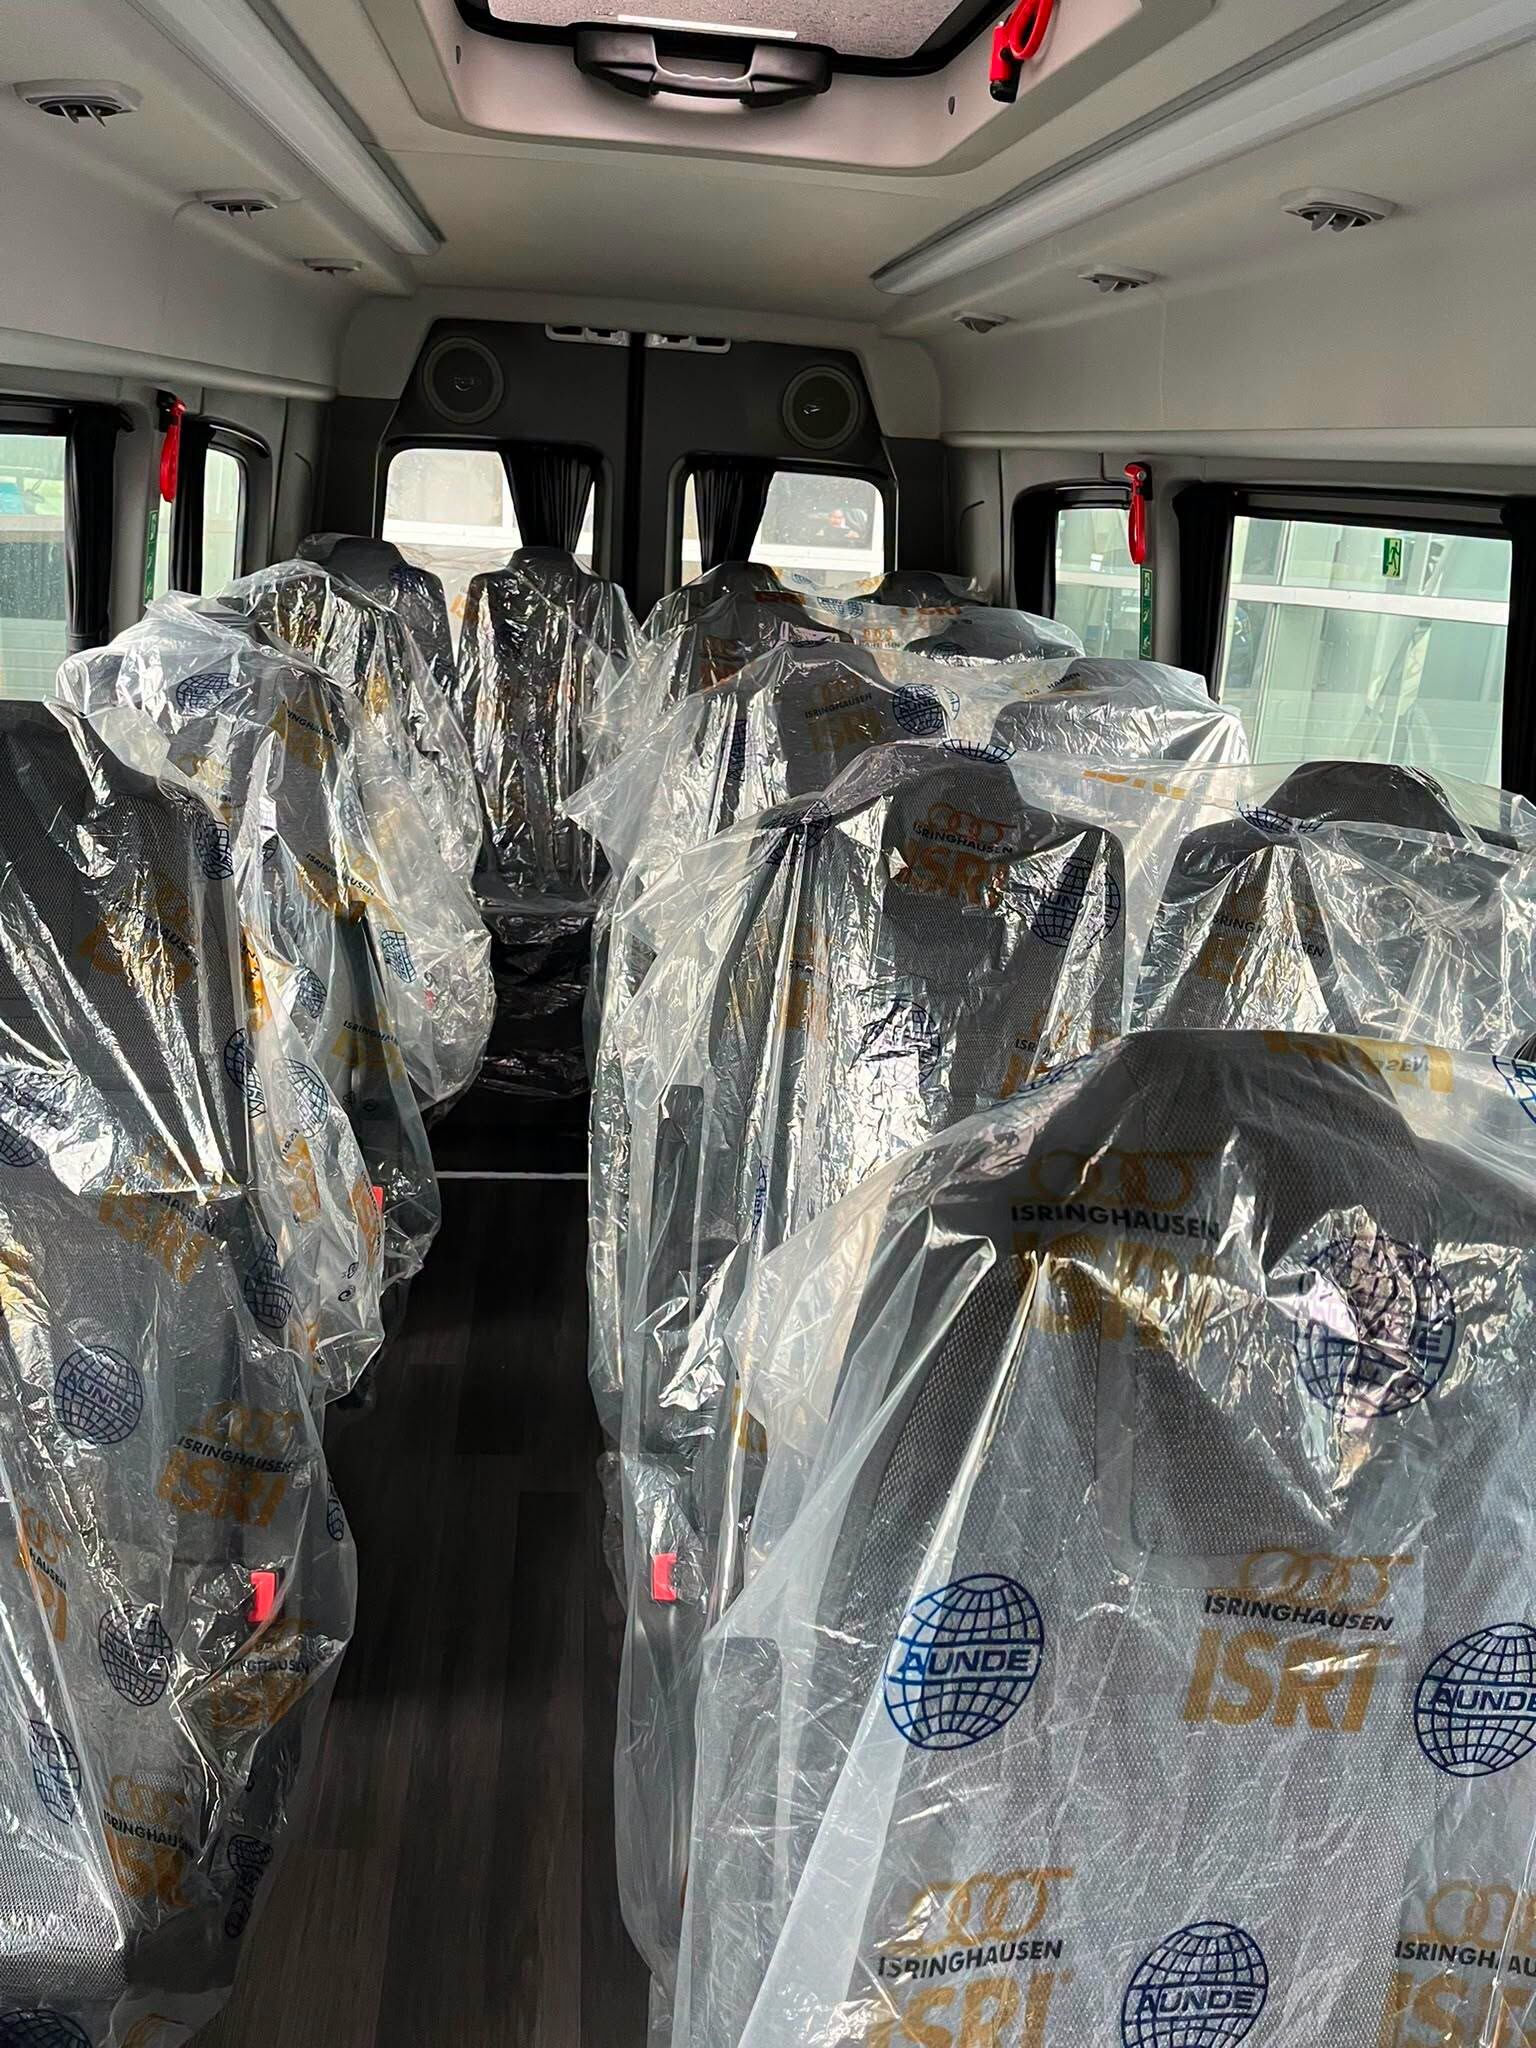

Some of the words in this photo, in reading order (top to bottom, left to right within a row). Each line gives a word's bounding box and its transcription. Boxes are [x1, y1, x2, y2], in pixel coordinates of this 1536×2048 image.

[1011, 1203, 1221, 1243] ISRINGHAUSEN
[177, 1435, 294, 1474] ISRINGHAUSEN
[1204, 1594, 1395, 1632] ISRINGHAUSEN
[898, 1648, 1032, 1676] AUNDE
[1183, 1628, 1378, 1734] ISRI
[878, 1939, 1065, 1981] ISRINGHAUSEN
[1135, 1989, 1257, 2016] AUNDE
